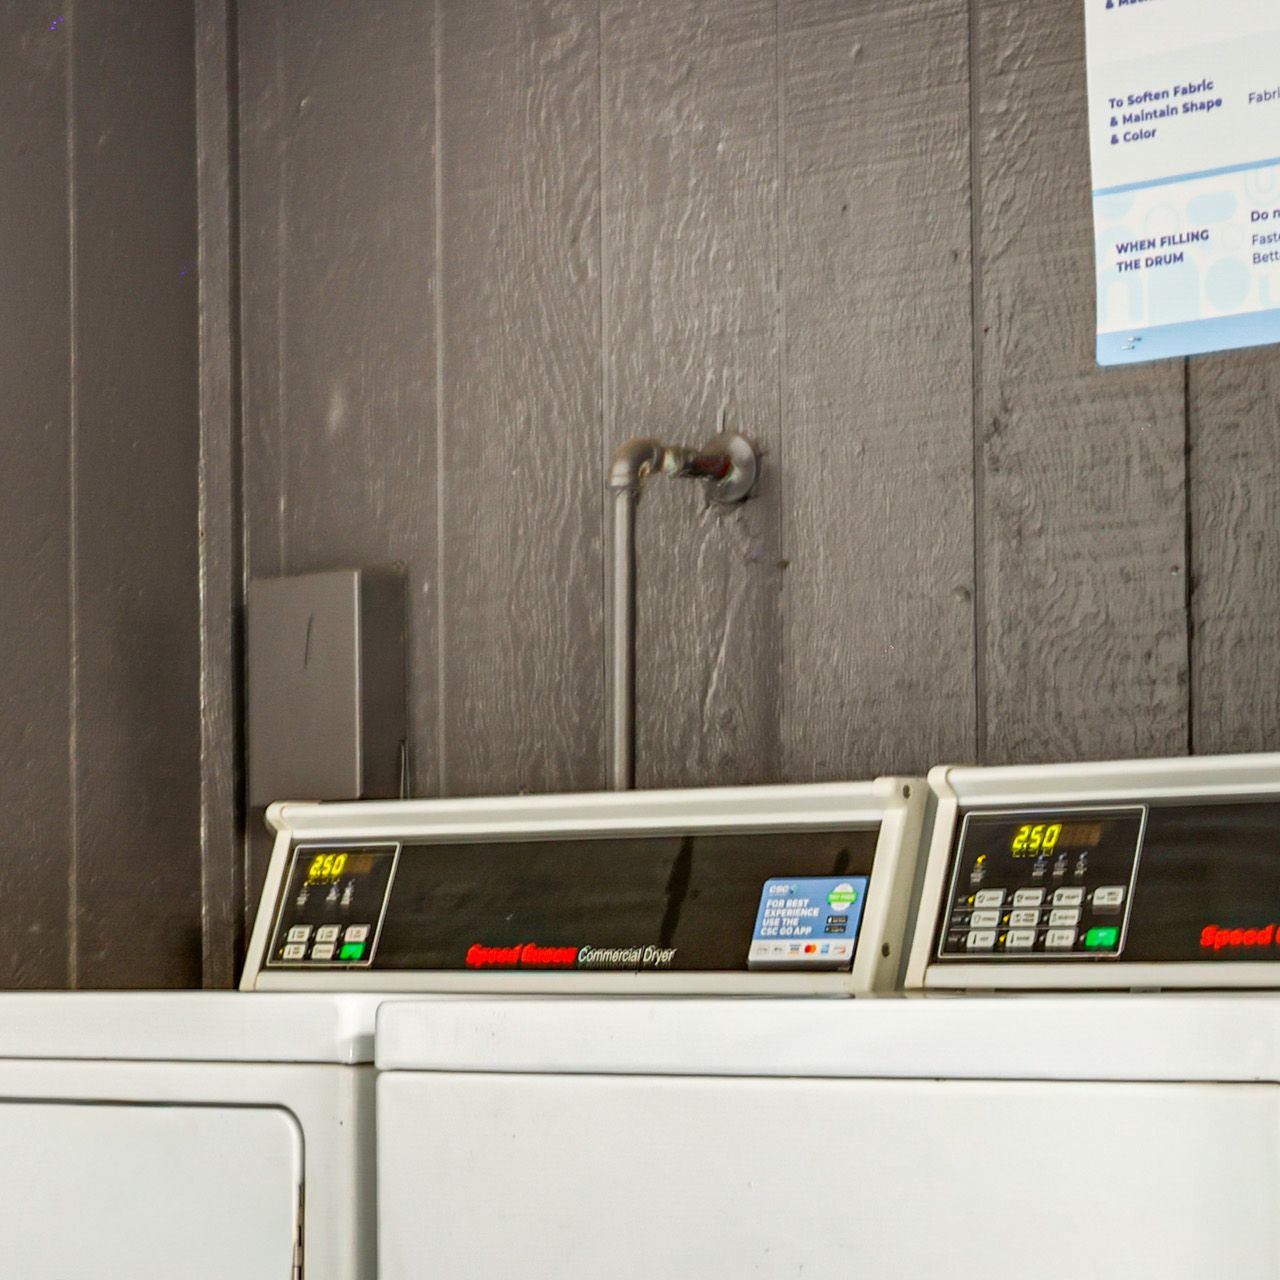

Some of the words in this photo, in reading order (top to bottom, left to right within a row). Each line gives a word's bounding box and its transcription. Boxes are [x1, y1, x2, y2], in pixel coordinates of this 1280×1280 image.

[1108, 98, 1124, 109] To
[1127, 89, 1169, 106] Soften
[1173, 79, 1214, 97] Fabric
[1110, 116, 1118, 127] &
[1122, 105, 1178, 125] Maintain
[1182, 98, 1223, 114] Shape
[1110, 134, 1119, 145] &
[1123, 128, 1157, 142] Color
[1251, 210, 1269, 222] Do
[1116, 238, 1156, 254] WHEN
[1160, 229, 1210, 247] FILLING
[1116, 259, 1141, 272] THE
[1145, 252, 1184, 268] DRUM
[767, 899, 785, 908] FOR
[786, 899, 809, 908] BEST
[765, 908, 819, 918] EXPERIENCE
[760, 927, 779, 936] CSC
[779, 927, 794, 936] GO
[794, 926, 813, 936] APP
[763, 918, 780, 927] USE
[782, 918, 800, 927] THE
[1200, 924, 1275, 949] Speed
[578, 944, 644, 963] Commercial
[643, 945, 677, 966] Dryer
